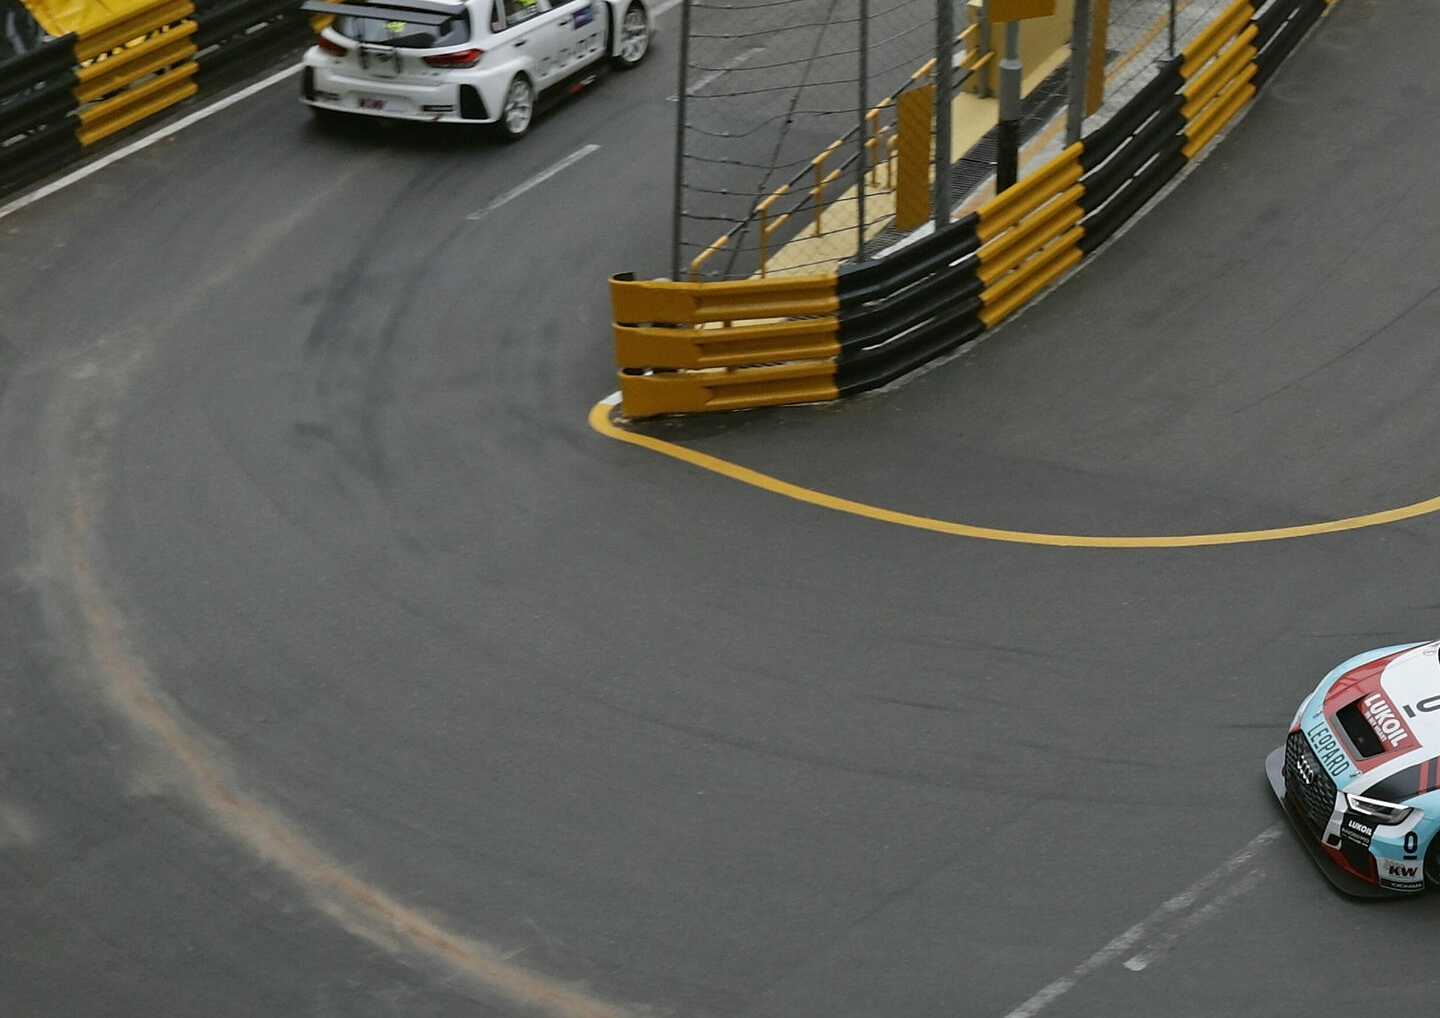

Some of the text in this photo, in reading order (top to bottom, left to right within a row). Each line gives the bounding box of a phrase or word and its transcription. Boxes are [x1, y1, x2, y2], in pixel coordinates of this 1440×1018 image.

[1363, 693, 1409, 748] LUKOIL
[1306, 721, 1351, 778] LEOPARD
[1348, 820, 1373, 836] LUKOIL
[1388, 865, 1418, 877] KW
